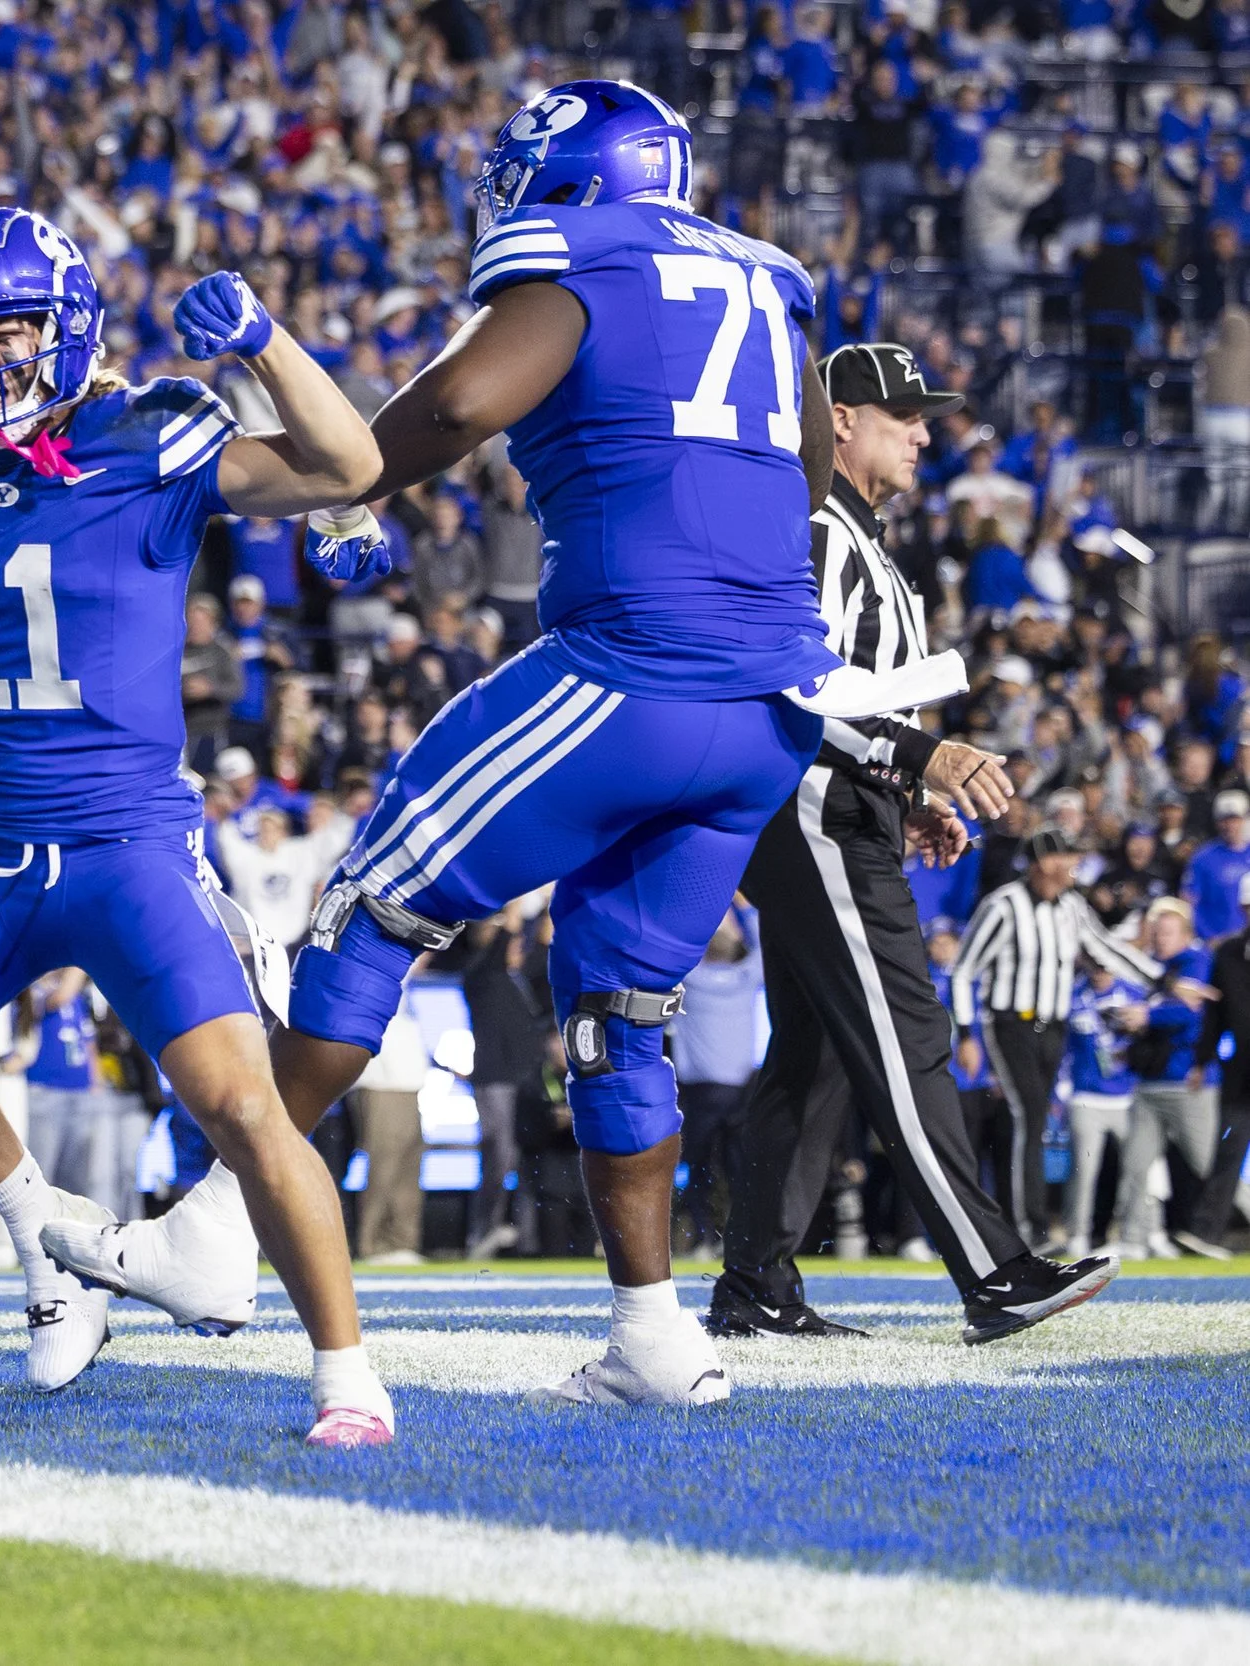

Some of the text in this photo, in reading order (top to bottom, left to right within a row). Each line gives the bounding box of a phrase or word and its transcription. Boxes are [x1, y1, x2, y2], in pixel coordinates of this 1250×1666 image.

[523, 98, 575, 134] Y
[644, 164, 659, 179] 71
[652, 254, 802, 456] 71
